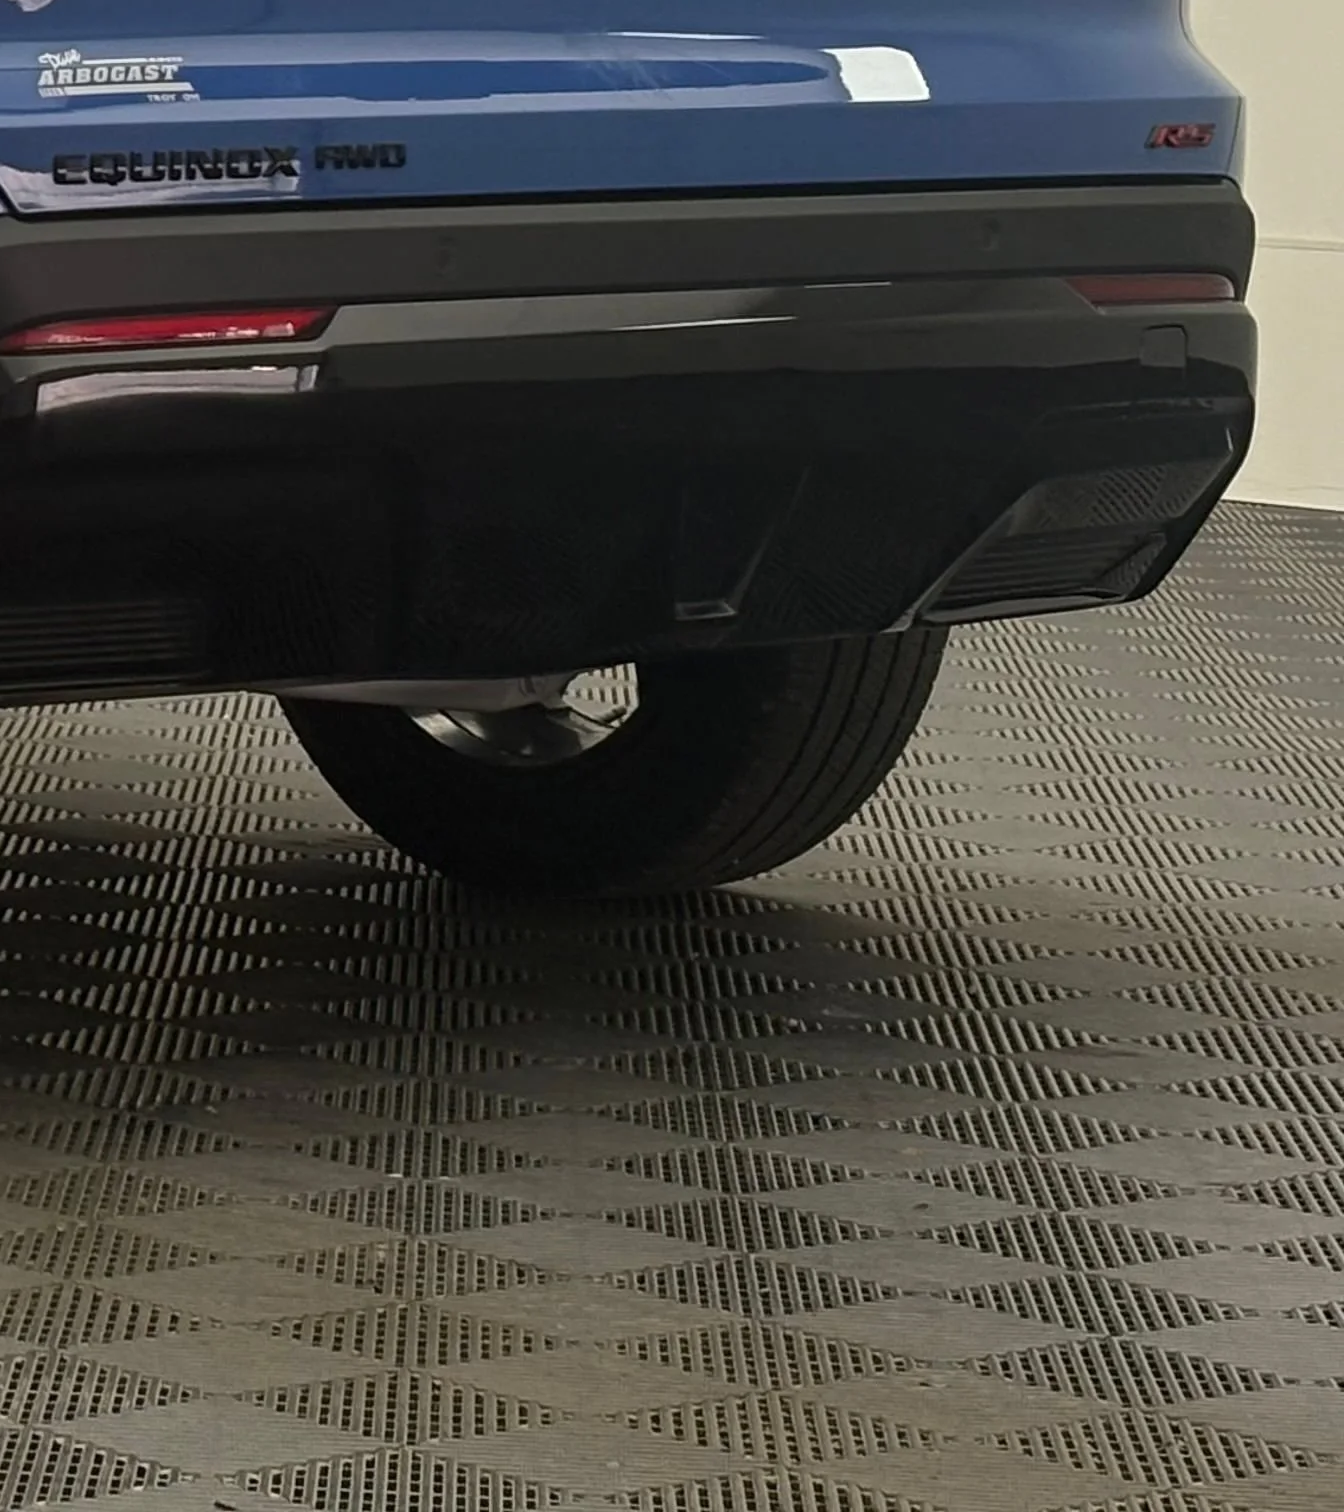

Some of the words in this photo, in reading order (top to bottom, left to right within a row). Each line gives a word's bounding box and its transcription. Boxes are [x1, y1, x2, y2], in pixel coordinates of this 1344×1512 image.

[37, 64, 179, 86] ARBOGAST
[1144, 123, 1217, 149] RS
[52, 146, 301, 186] EQUINOX
[313, 143, 406, 171] AWD
